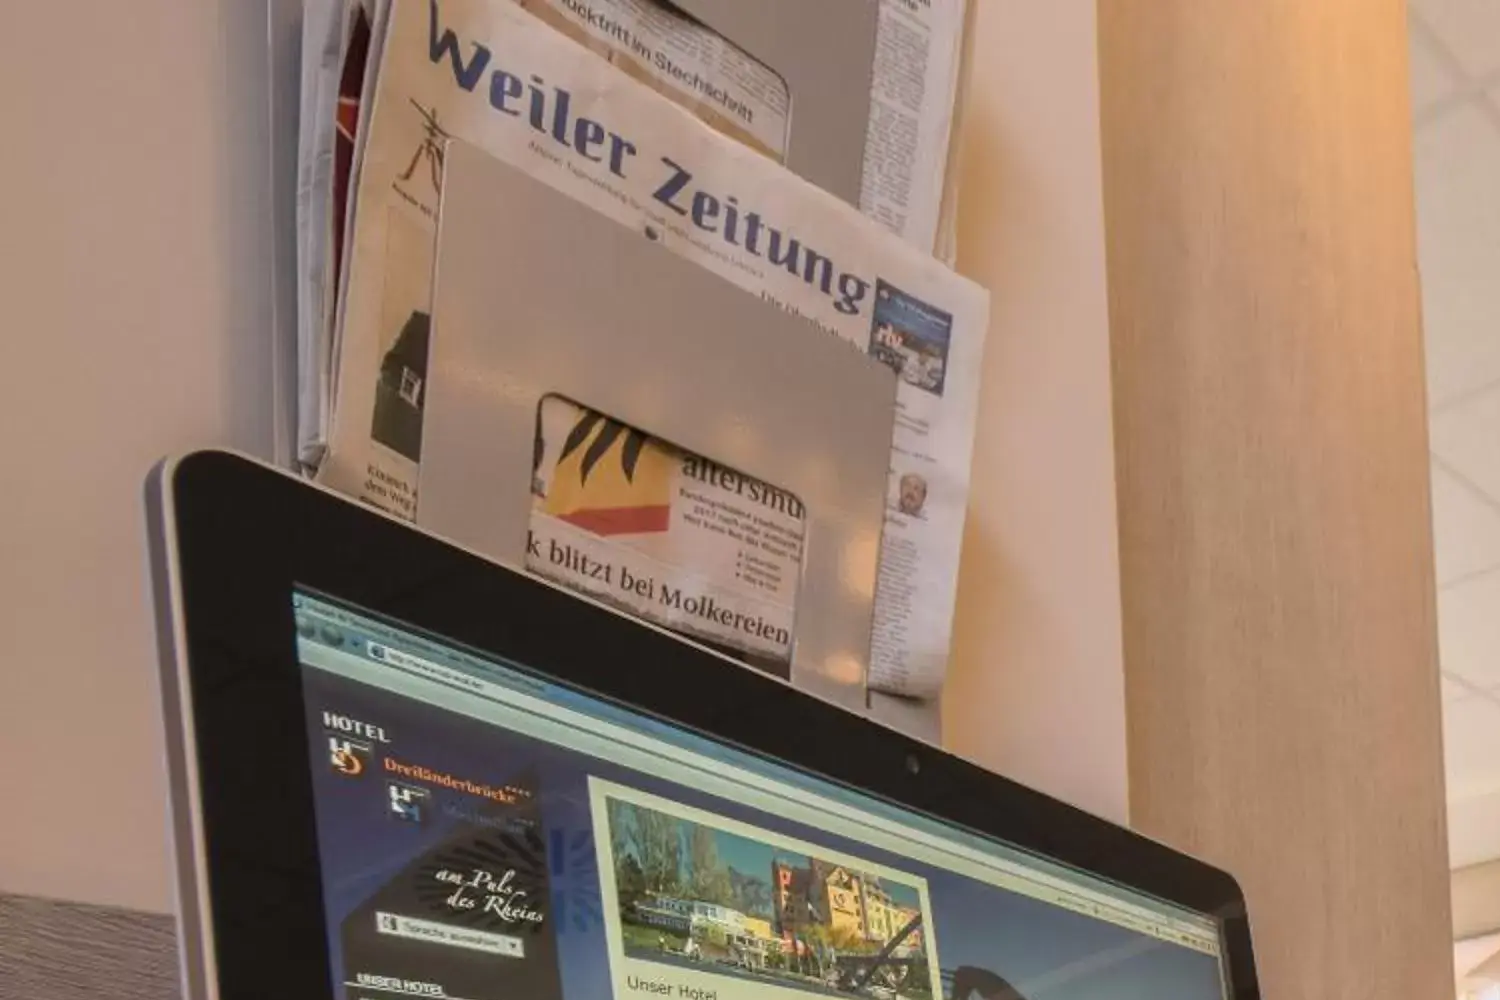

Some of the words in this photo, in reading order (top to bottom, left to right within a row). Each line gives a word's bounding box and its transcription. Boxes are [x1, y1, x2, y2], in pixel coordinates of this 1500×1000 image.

[631, 35, 651, 61] im
[654, 50, 754, 124] Stechschritt
[429, 0, 637, 180] Weiler
[651, 155, 871, 316] Zeitung
[526, 530, 541, 557] k
[549, 539, 613, 583] blitzt
[620, 567, 654, 599] bei
[659, 584, 789, 645] Molkereien
[322, 711, 391, 743] HOTEL
[435, 868, 462, 885] am
[466, 869, 516, 894] Puls
[447, 886, 476, 910] des
[484, 891, 543, 922] Rheins
[404, 980, 444, 996] HOTEL
[627, 975, 673, 996] Unser
